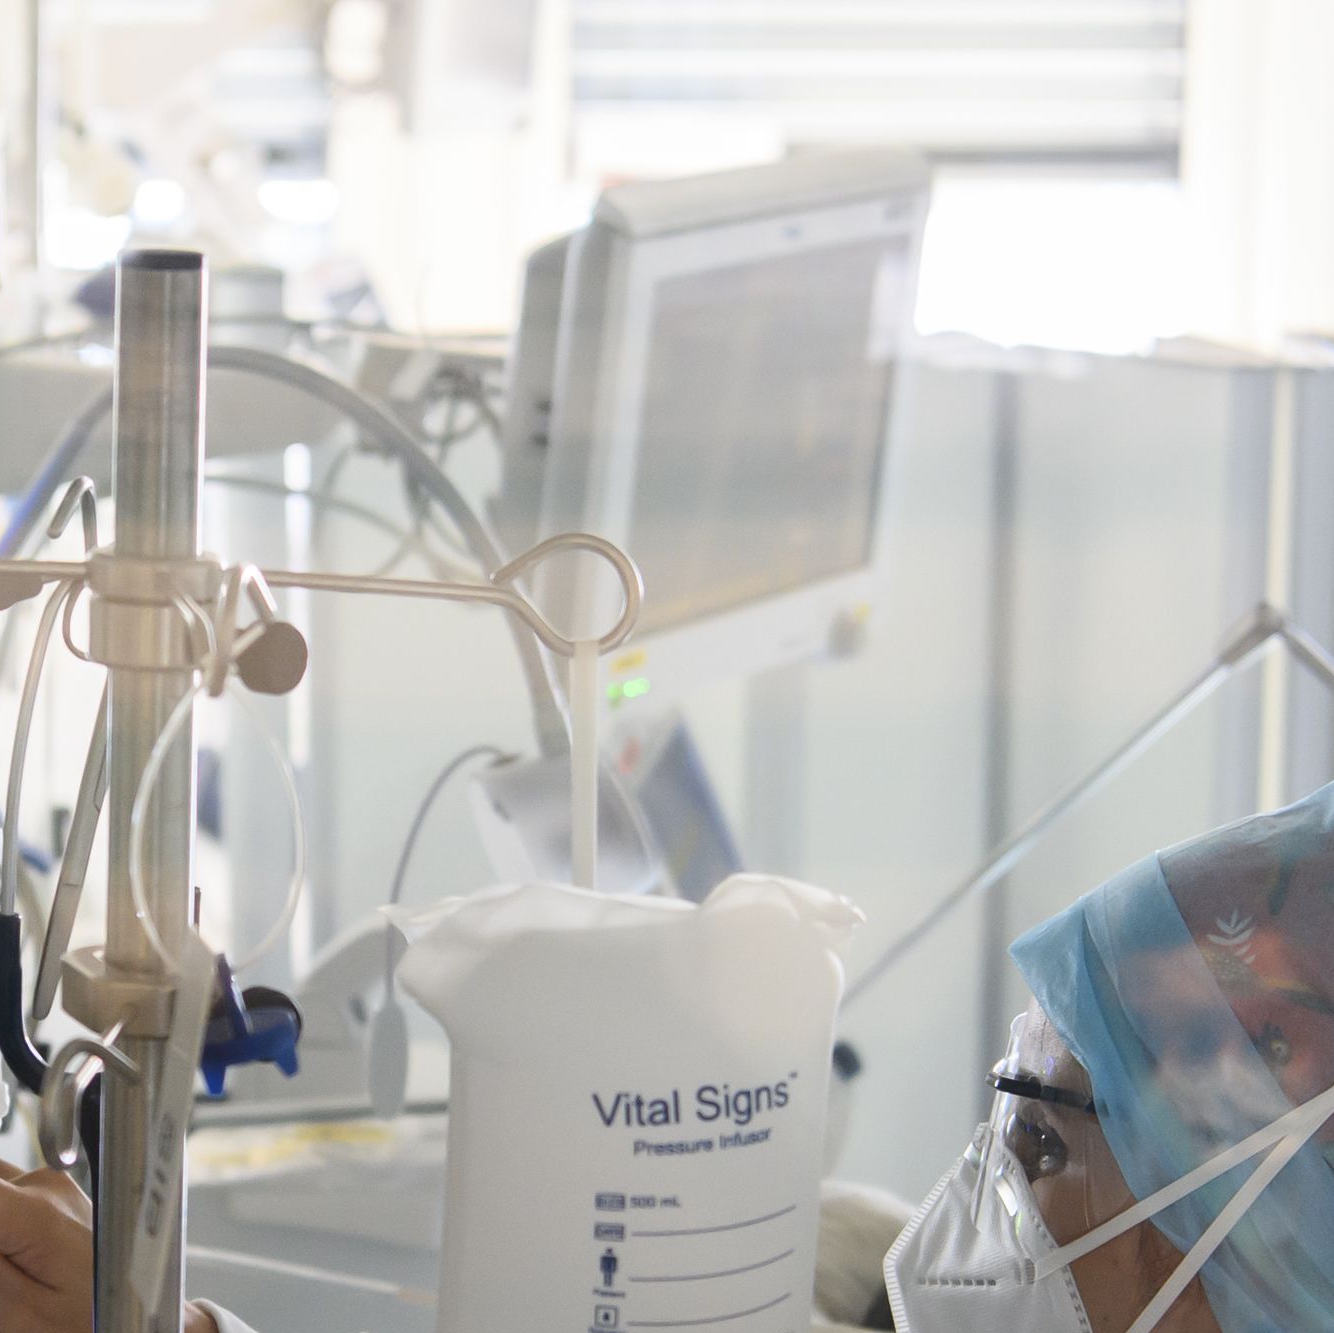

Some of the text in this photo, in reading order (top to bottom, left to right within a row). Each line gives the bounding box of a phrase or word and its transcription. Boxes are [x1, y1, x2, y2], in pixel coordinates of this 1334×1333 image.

[591, 1091, 681, 1127] Vital
[633, 1127, 772, 1157] Pressure Infusor
